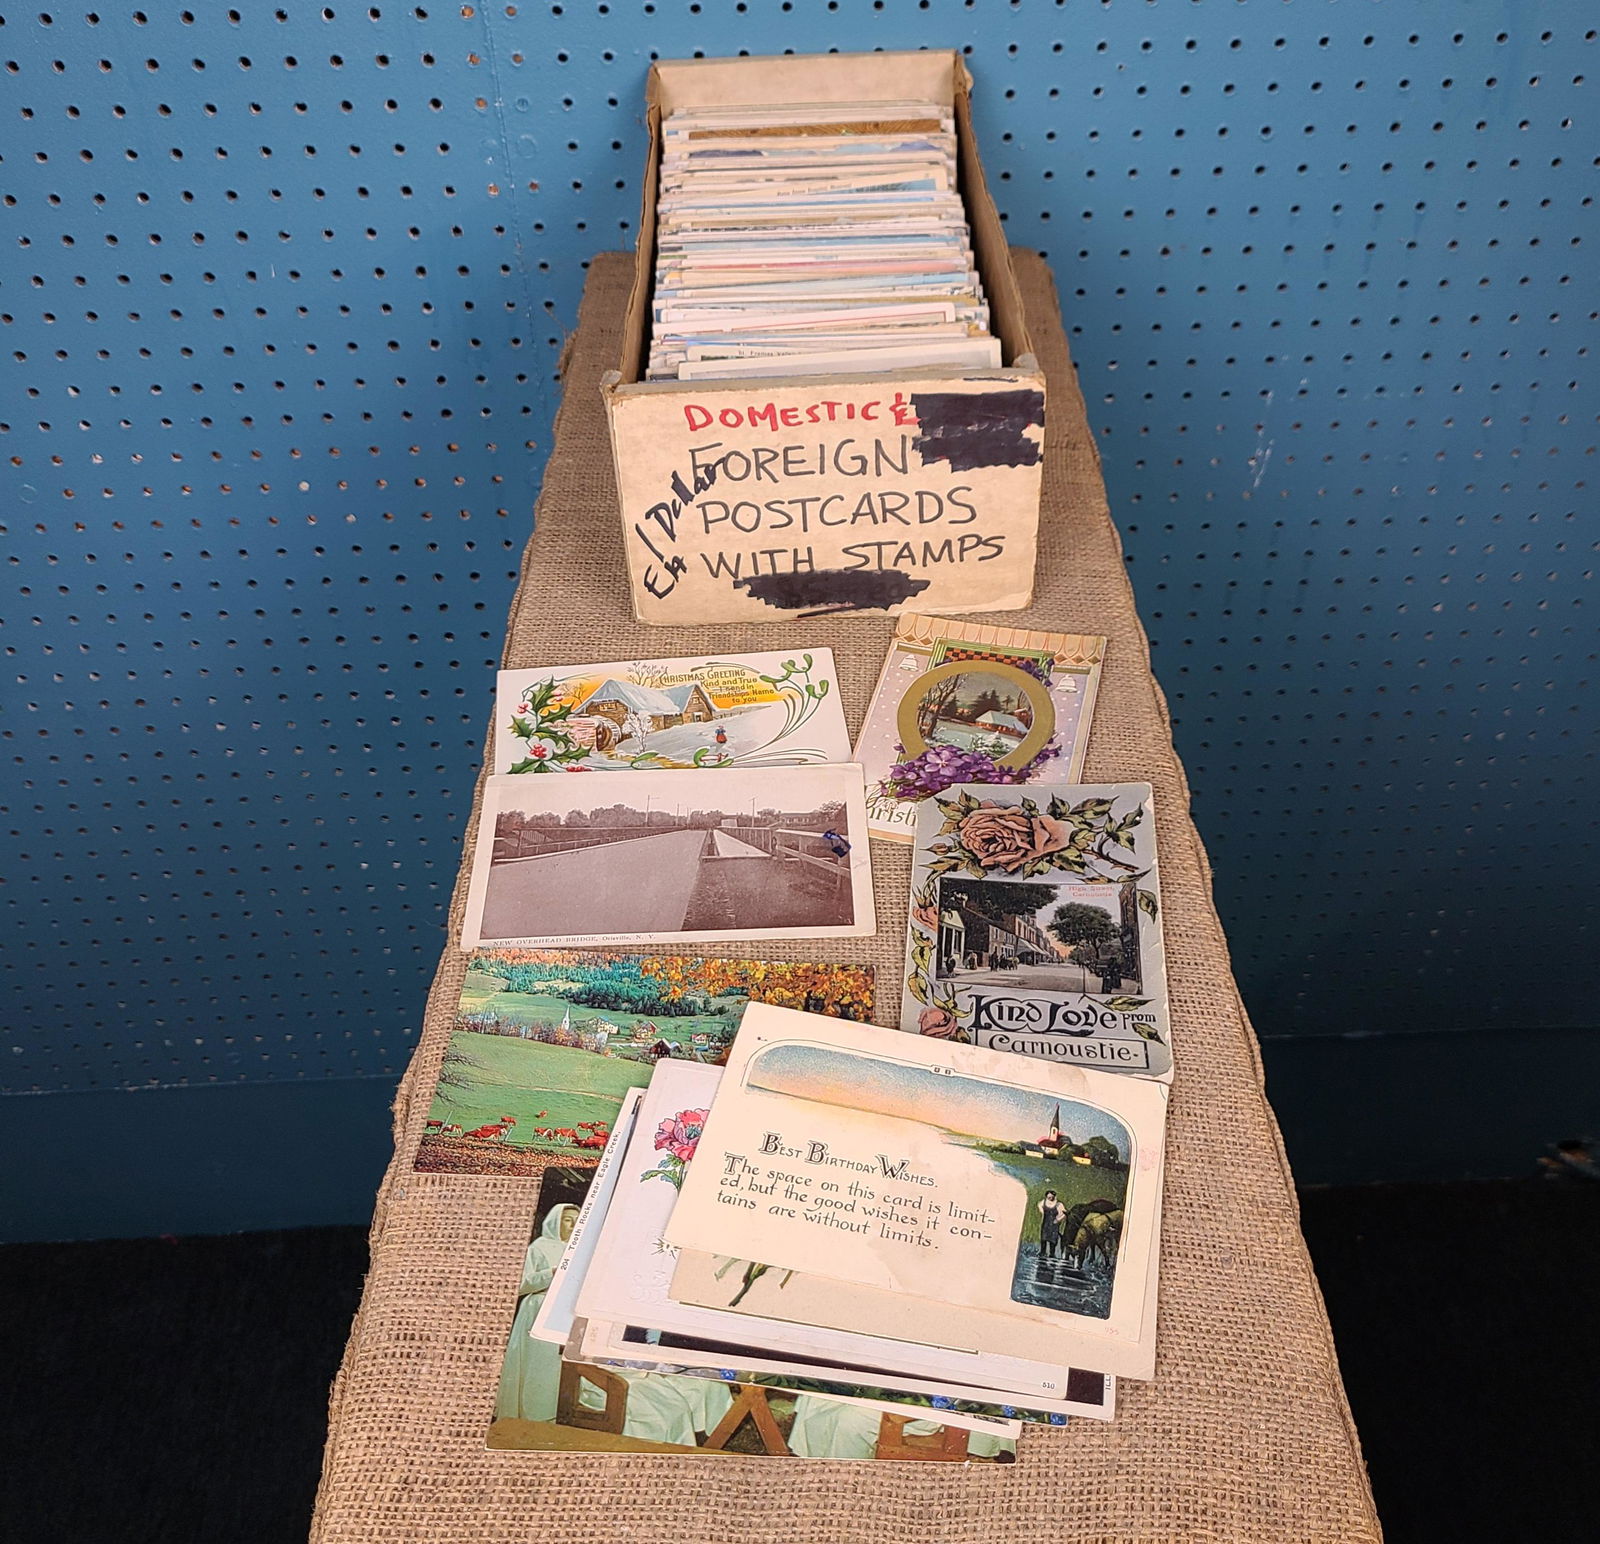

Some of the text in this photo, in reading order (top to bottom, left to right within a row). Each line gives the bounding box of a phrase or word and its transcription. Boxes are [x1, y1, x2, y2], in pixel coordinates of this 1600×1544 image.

[684, 400, 880, 431] DOMESTIC
[688, 434, 910, 483] FOREIGN
[696, 486, 977, 533] POSTCARDS
[700, 533, 1007, 579] WITH STAMPS
[660, 667, 746, 686] CHRISTMAS GREETING
[700, 680, 720, 689] Kind
[722, 678, 737, 686] and
[516, 937, 562, 945] OVERHEAD
[758, 1131, 939, 1188] BEST BIRTHDAY WISHES.
[568, 1228, 582, 1251] Tooth
[579, 1201, 593, 1225] Rocks
[591, 1181, 601, 1198] near
[597, 1157, 609, 1178] Eagle
[607, 1130, 622, 1154] Creek,
[720, 1174, 993, 1240] ed, but the good wishes it con-
[724, 1152, 995, 1224] The space on this card is limit-
[717, 1189, 939, 1249] tains are without limits.
[1042, 1381, 1056, 1390] 510
